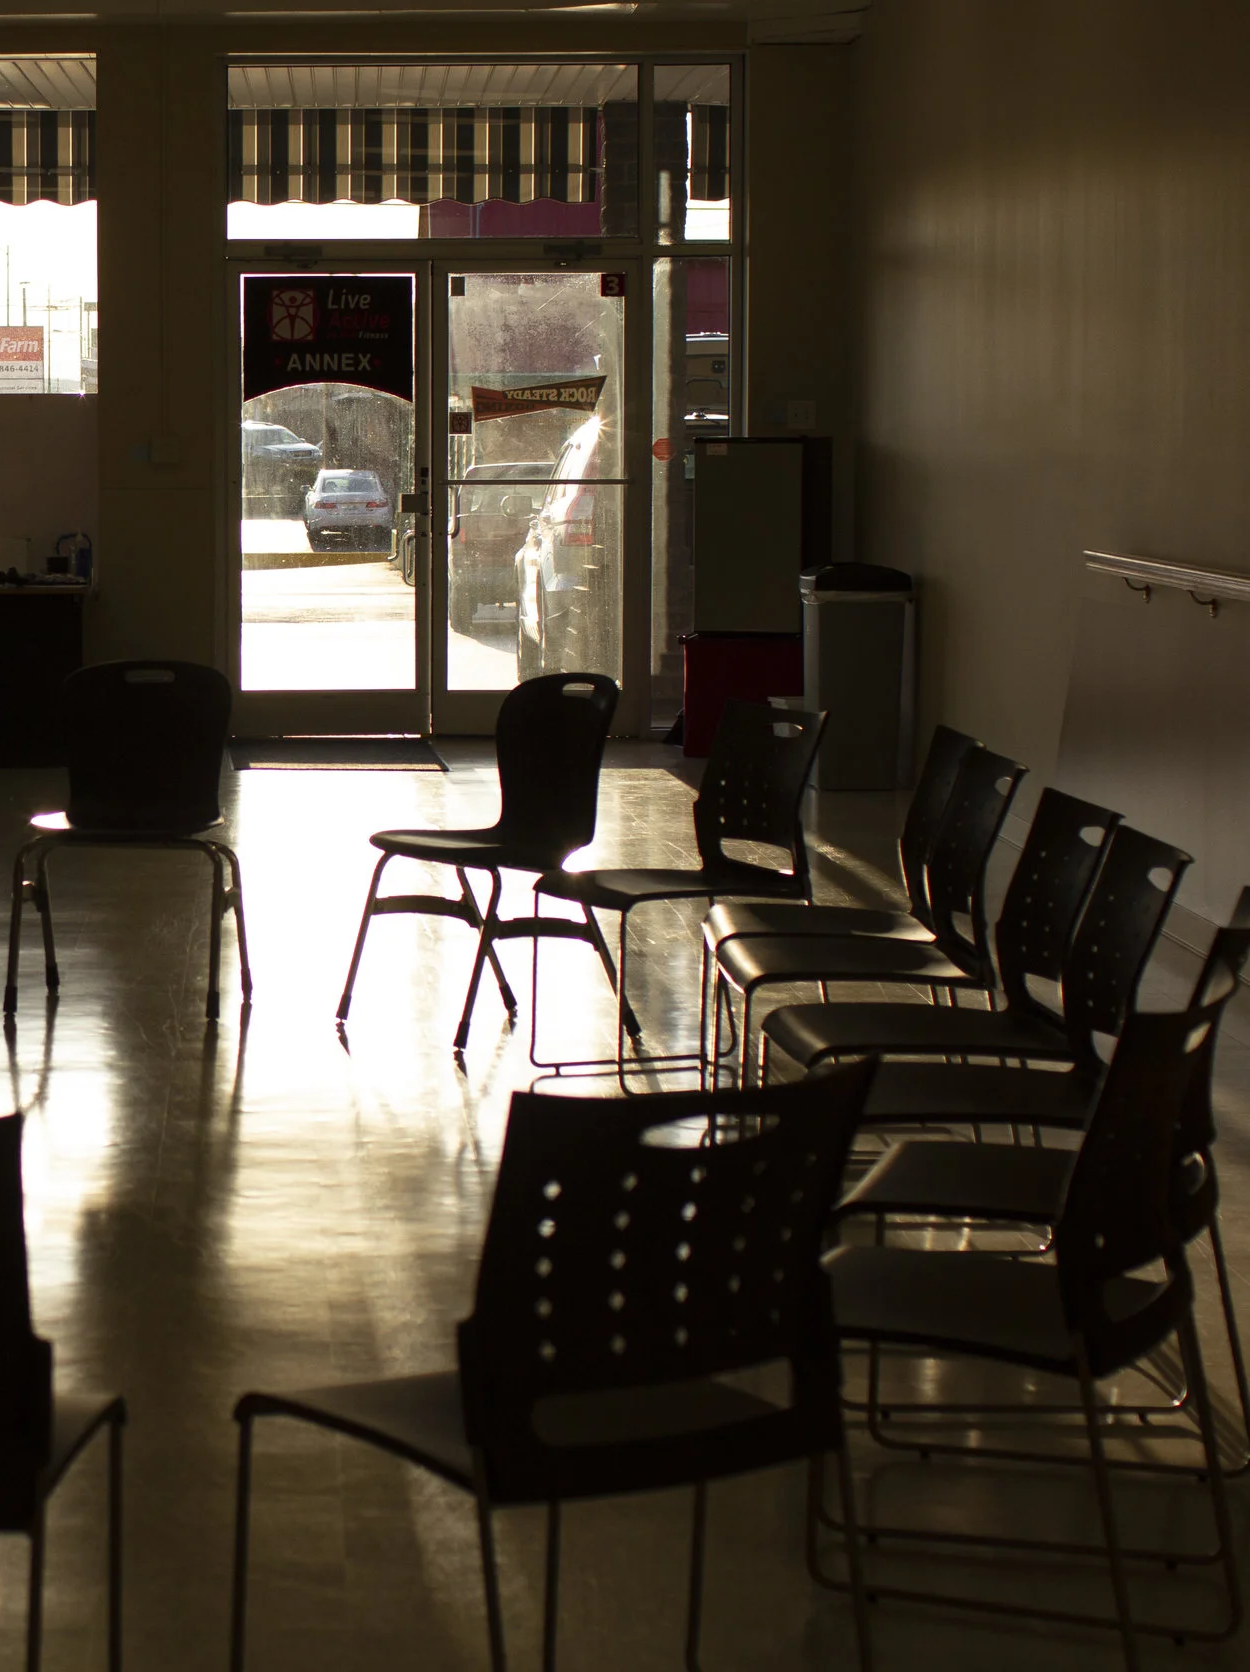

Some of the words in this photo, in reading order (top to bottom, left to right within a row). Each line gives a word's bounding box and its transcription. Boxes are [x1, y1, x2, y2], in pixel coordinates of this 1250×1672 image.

[606, 276, 620, 295] 3
[327, 289, 372, 310] Live
[328, 311, 391, 329] Active
[358, 331, 389, 340] Fitness
[286, 353, 372, 372] ANNEX
